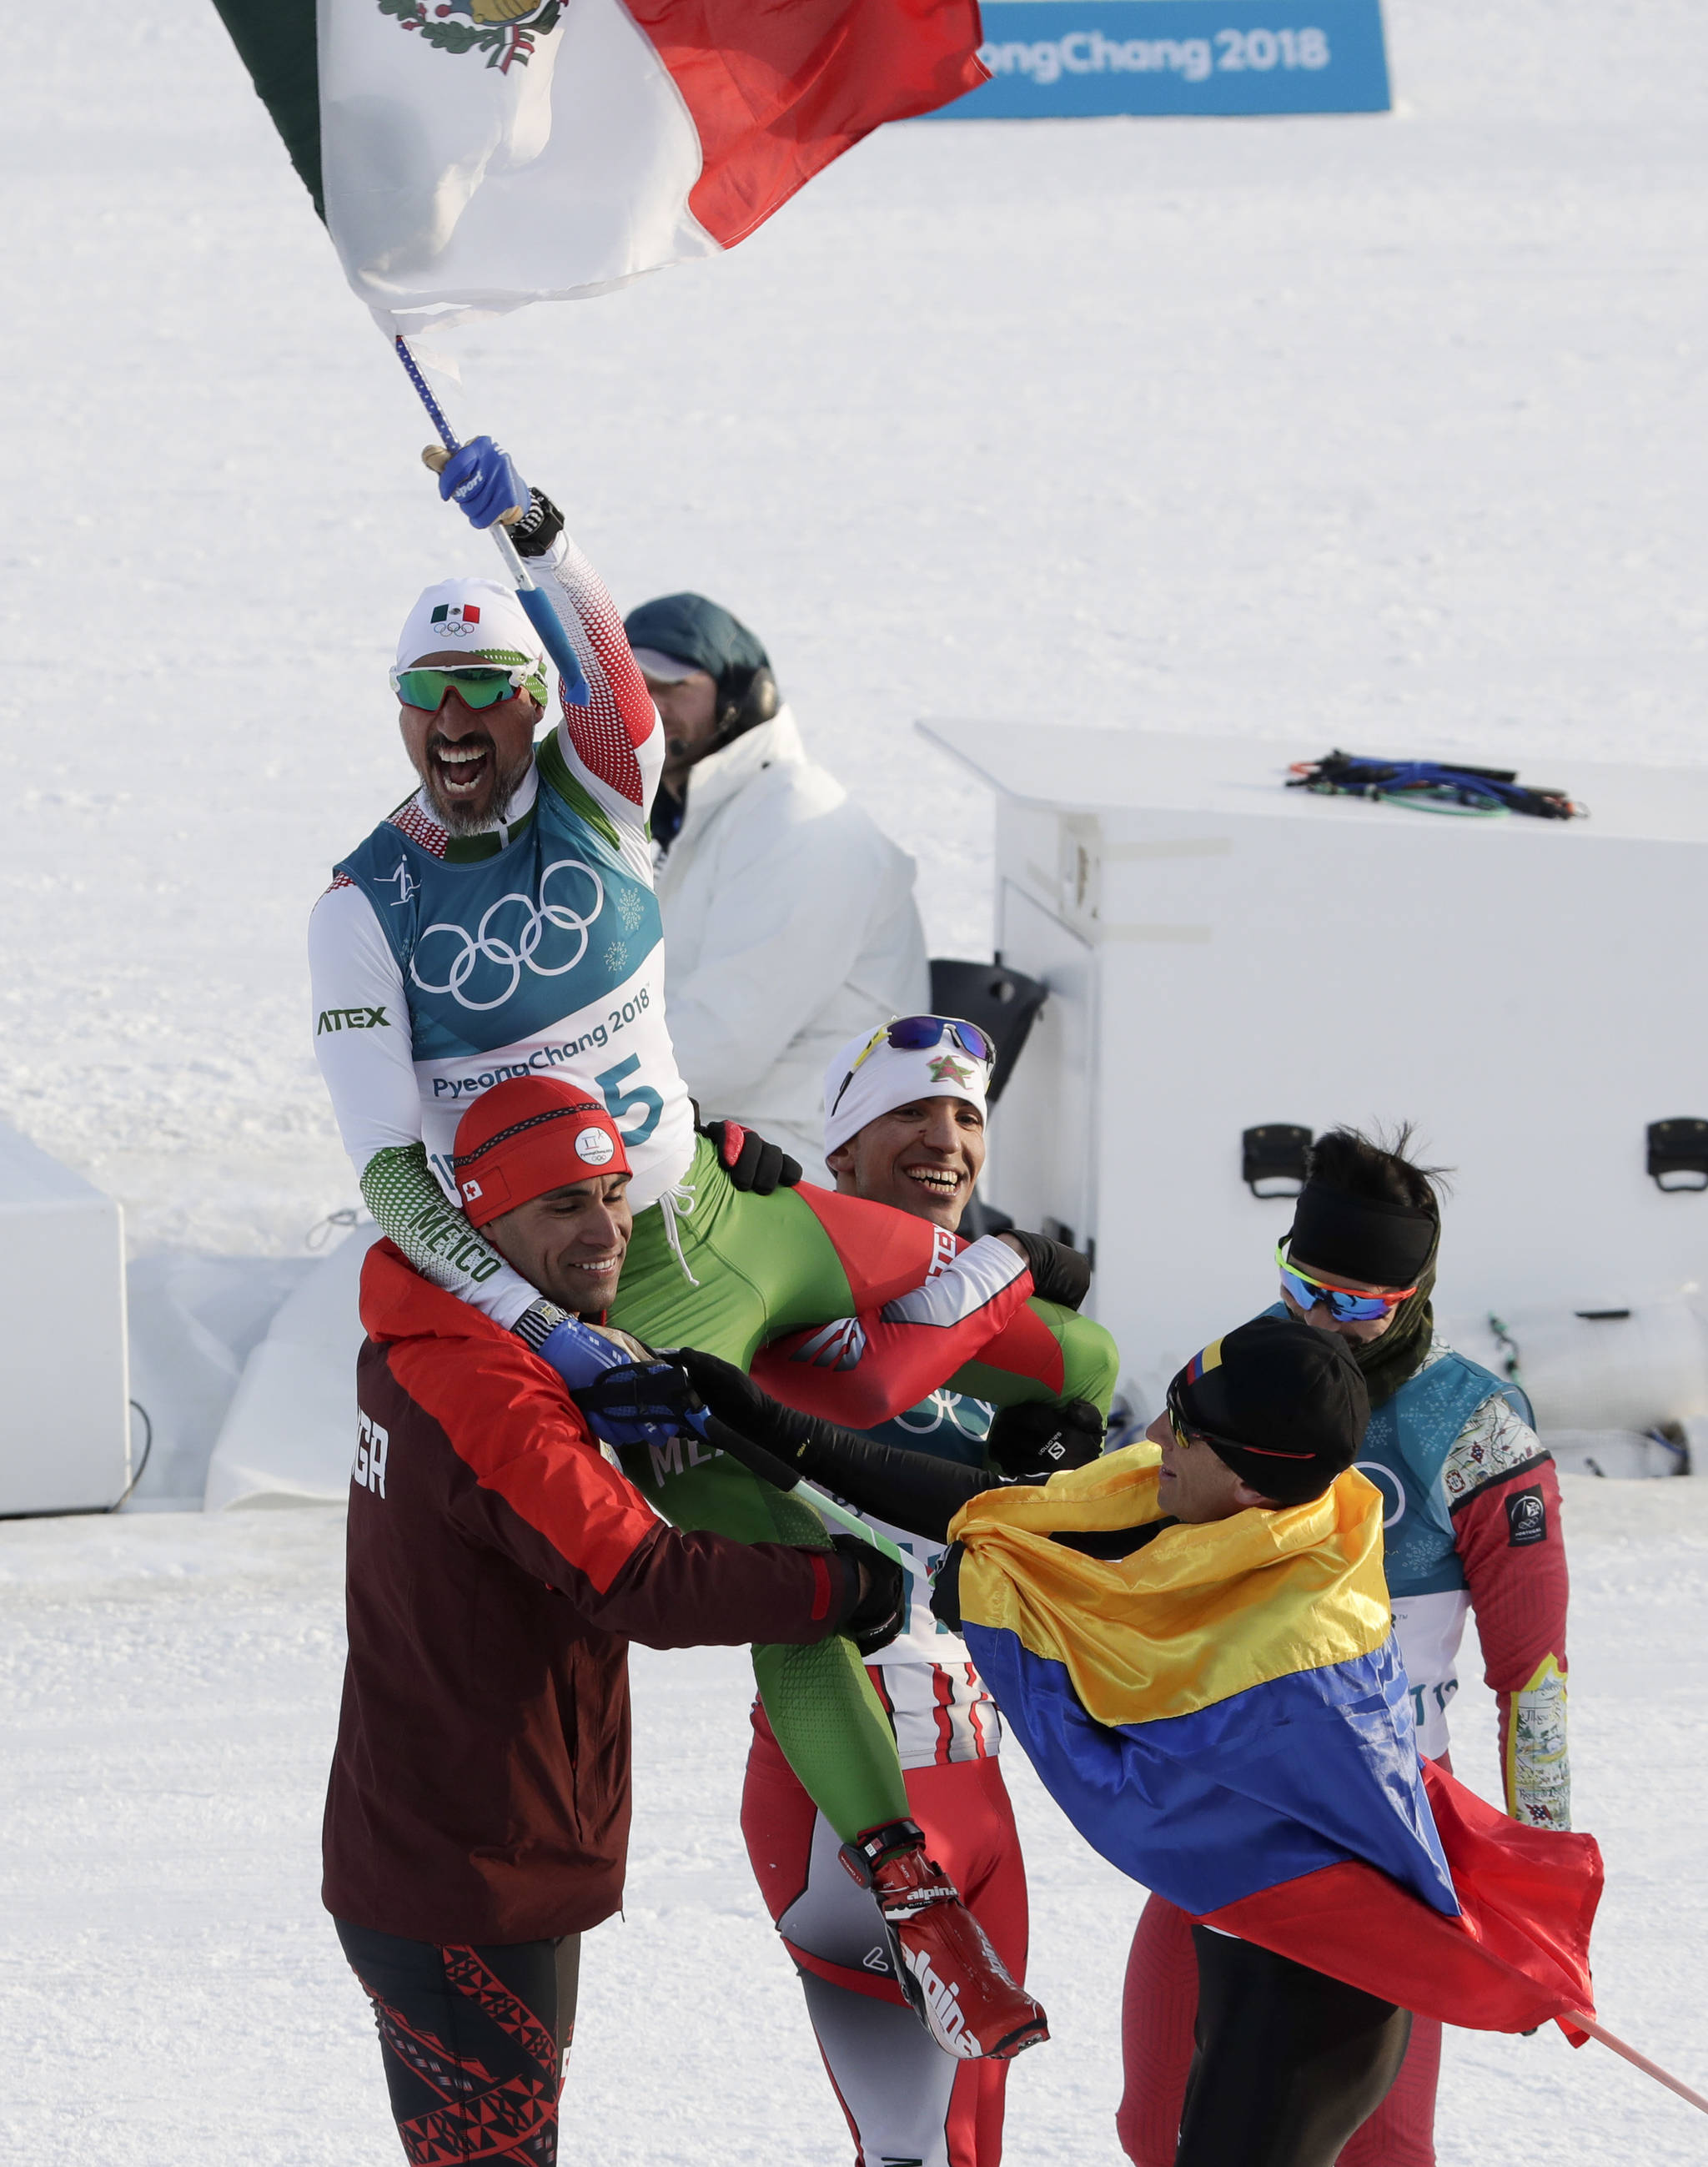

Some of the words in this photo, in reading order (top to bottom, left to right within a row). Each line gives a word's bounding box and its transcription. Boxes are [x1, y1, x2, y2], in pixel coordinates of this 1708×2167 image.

[1217, 28, 1331, 70] 2018
[317, 1006, 391, 1036] ATEX
[433, 1024, 609, 1099] PyeongChang
[608, 988, 650, 1033] 2018
[353, 1407, 389, 1499] GA
[907, 1886, 958, 1900] alpina
[900, 1942, 983, 2057] alpina
